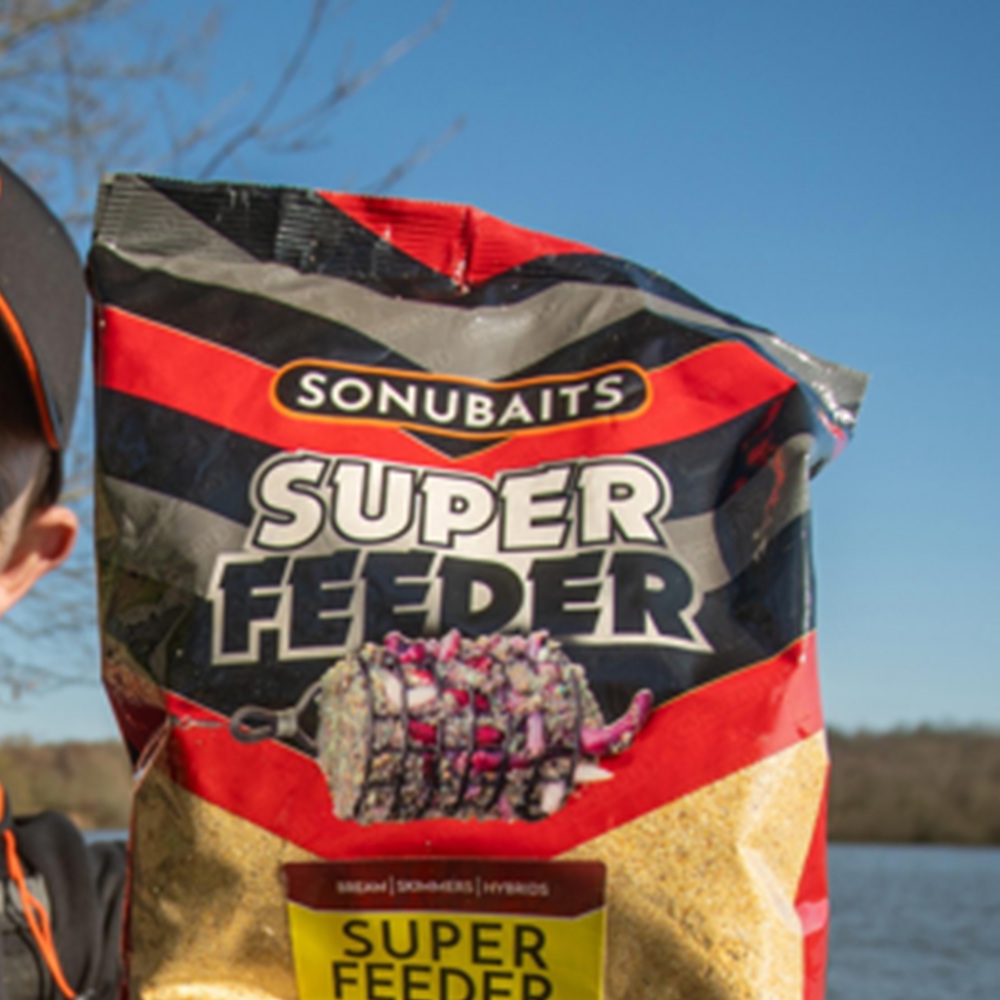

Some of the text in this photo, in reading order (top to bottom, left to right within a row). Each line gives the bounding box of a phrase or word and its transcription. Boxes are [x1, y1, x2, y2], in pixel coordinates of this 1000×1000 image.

[297, 373, 625, 428] SONUBAITS
[245, 449, 673, 556] SUPER
[206, 550, 714, 665] FEEDER
[342, 919, 548, 970] SUPER
